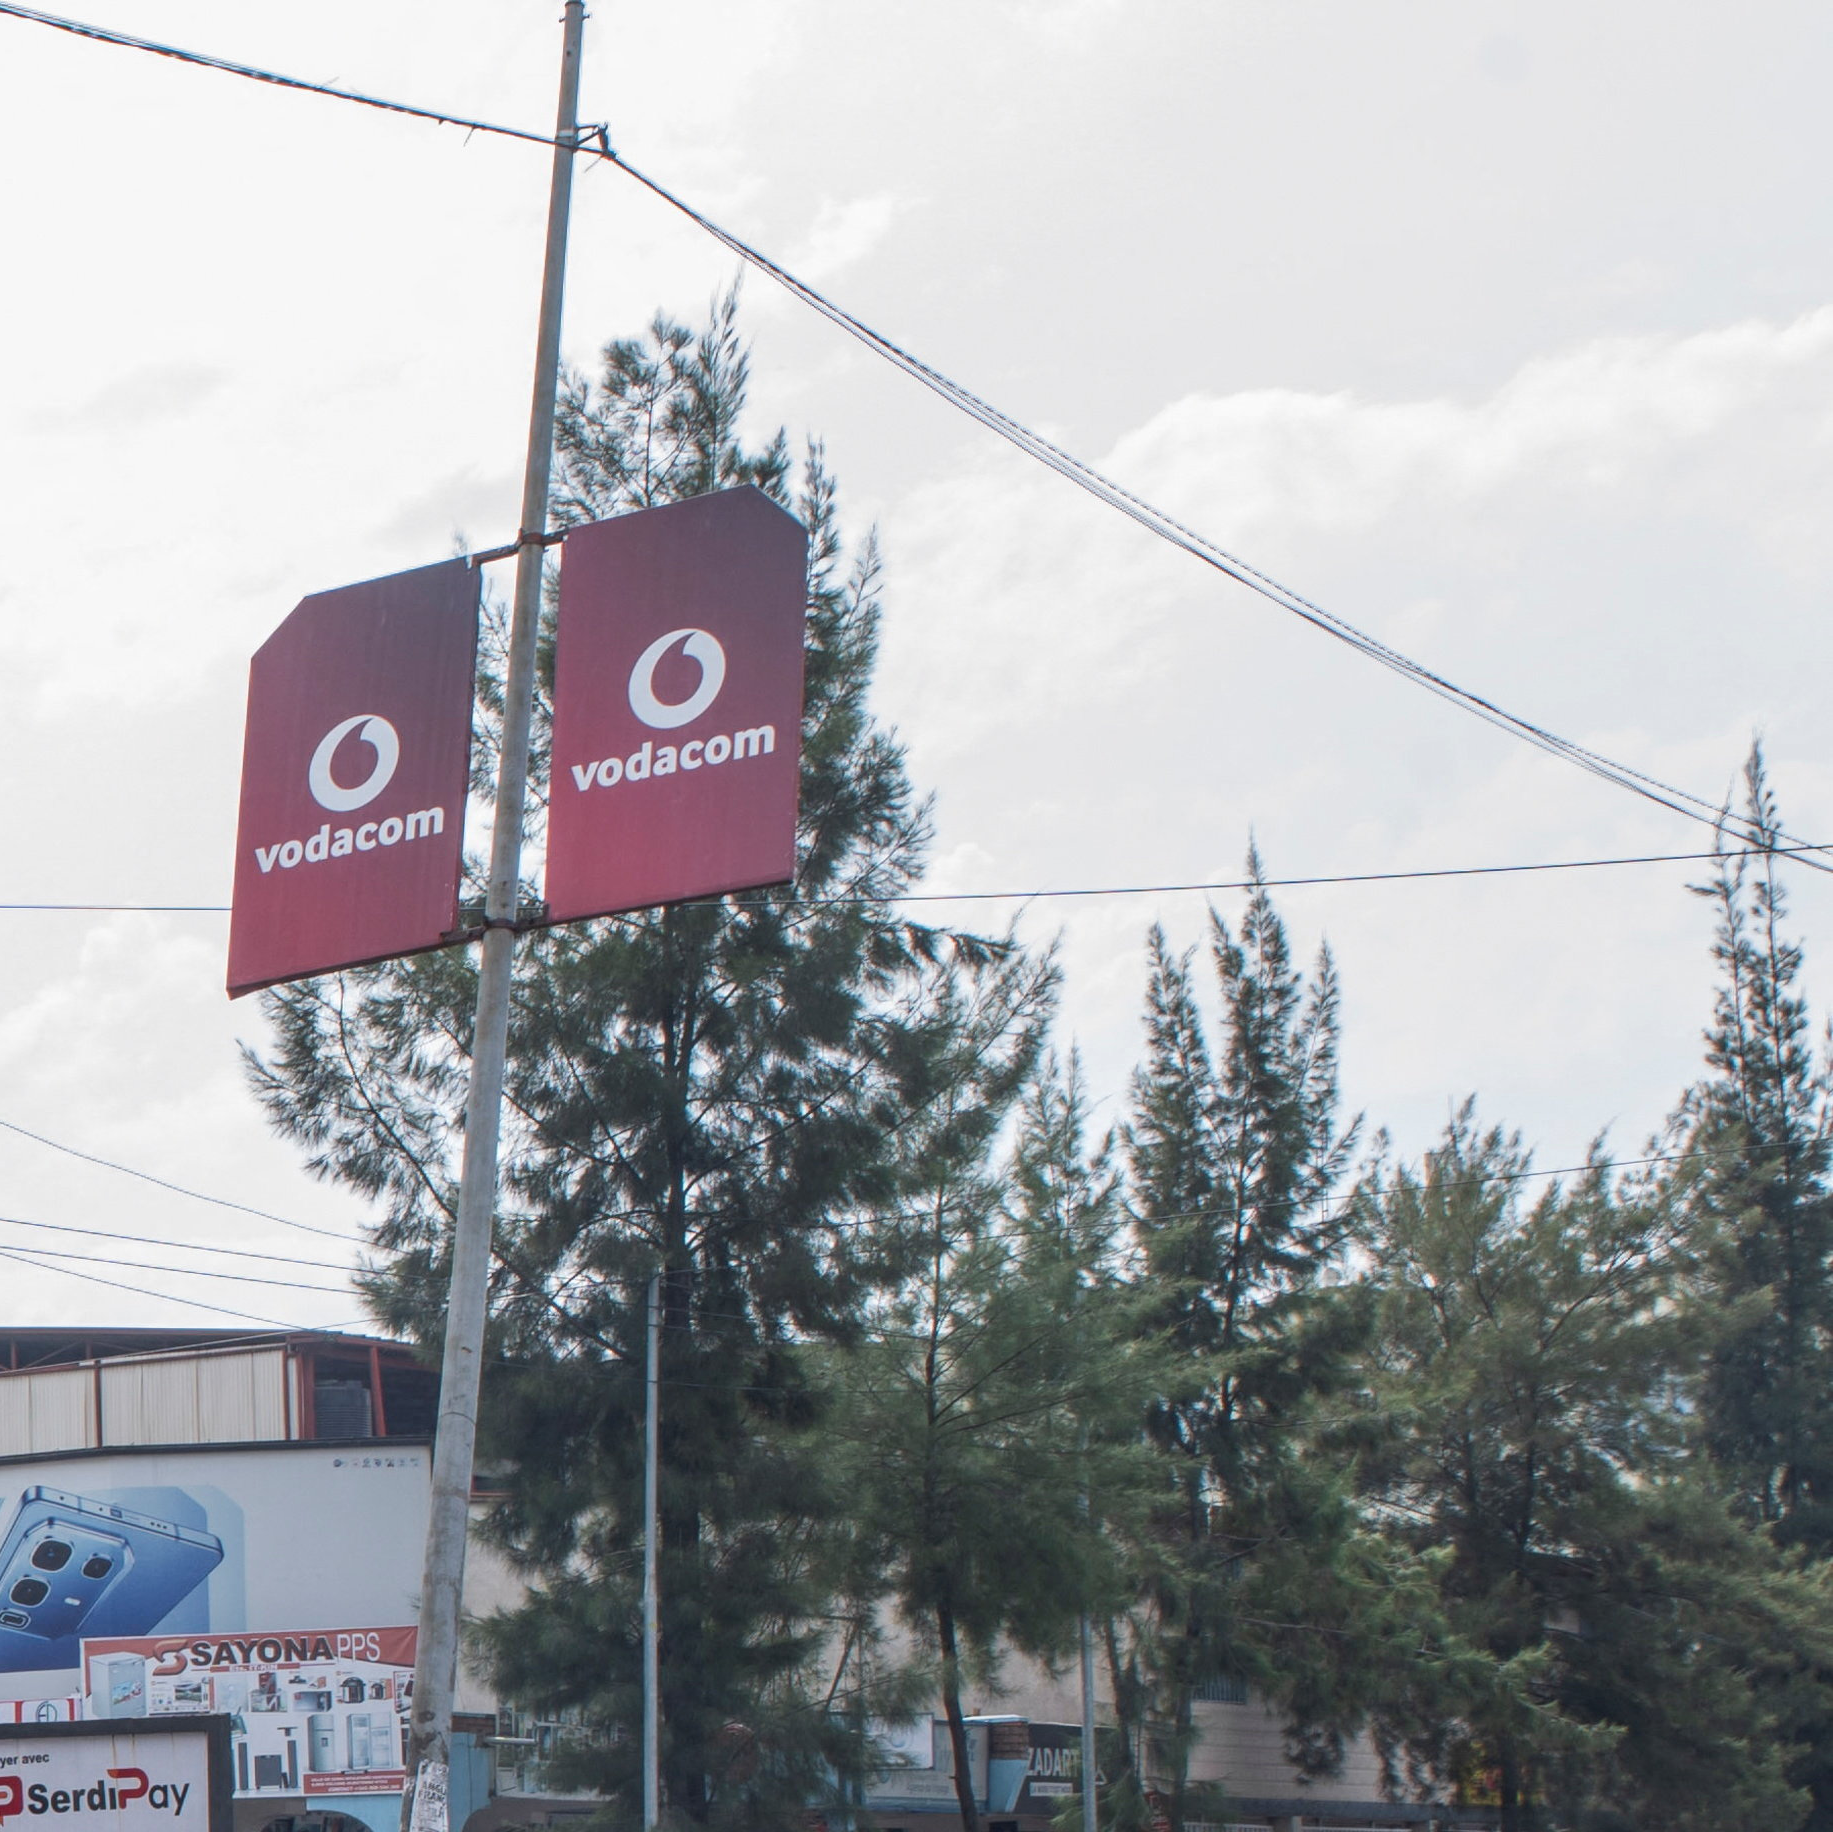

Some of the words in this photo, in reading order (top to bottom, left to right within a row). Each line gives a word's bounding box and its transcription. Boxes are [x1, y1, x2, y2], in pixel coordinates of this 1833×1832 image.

[571, 724, 775, 792] vodacom
[254, 806, 444, 873] vodacom
[190, 1636, 334, 1666] SAYONA
[336, 1631, 381, 1662] PPS
[22, 1753, 50, 1765] avec
[27, 1767, 190, 1816] SerdiPay
